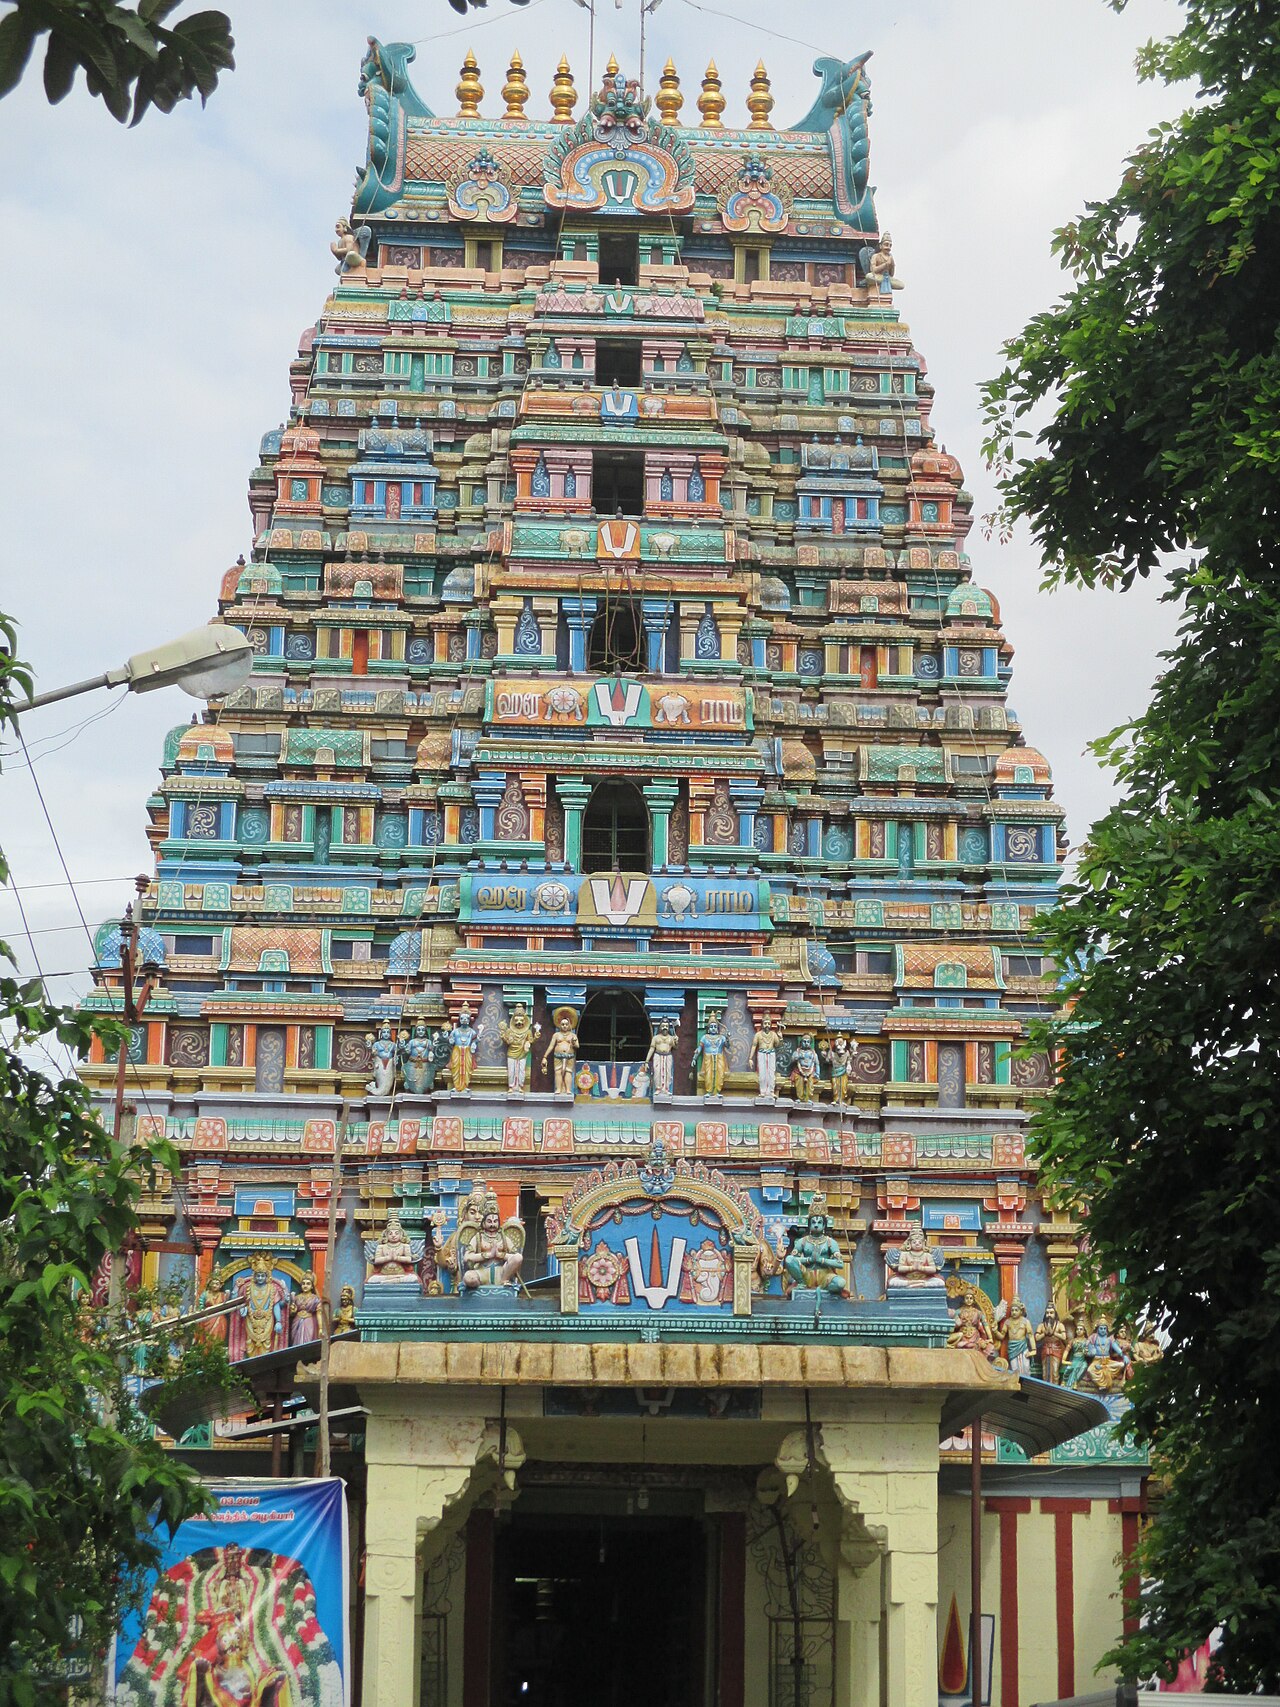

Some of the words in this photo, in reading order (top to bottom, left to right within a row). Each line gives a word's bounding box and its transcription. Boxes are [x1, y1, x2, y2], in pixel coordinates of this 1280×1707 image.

[497, 692, 541, 720] ஹரே
[701, 699, 745, 725] ராம
[477, 885, 527, 913] ஹரே
[705, 889, 754, 916] ராம
[220, 1496, 260, 1506] 03.2016
